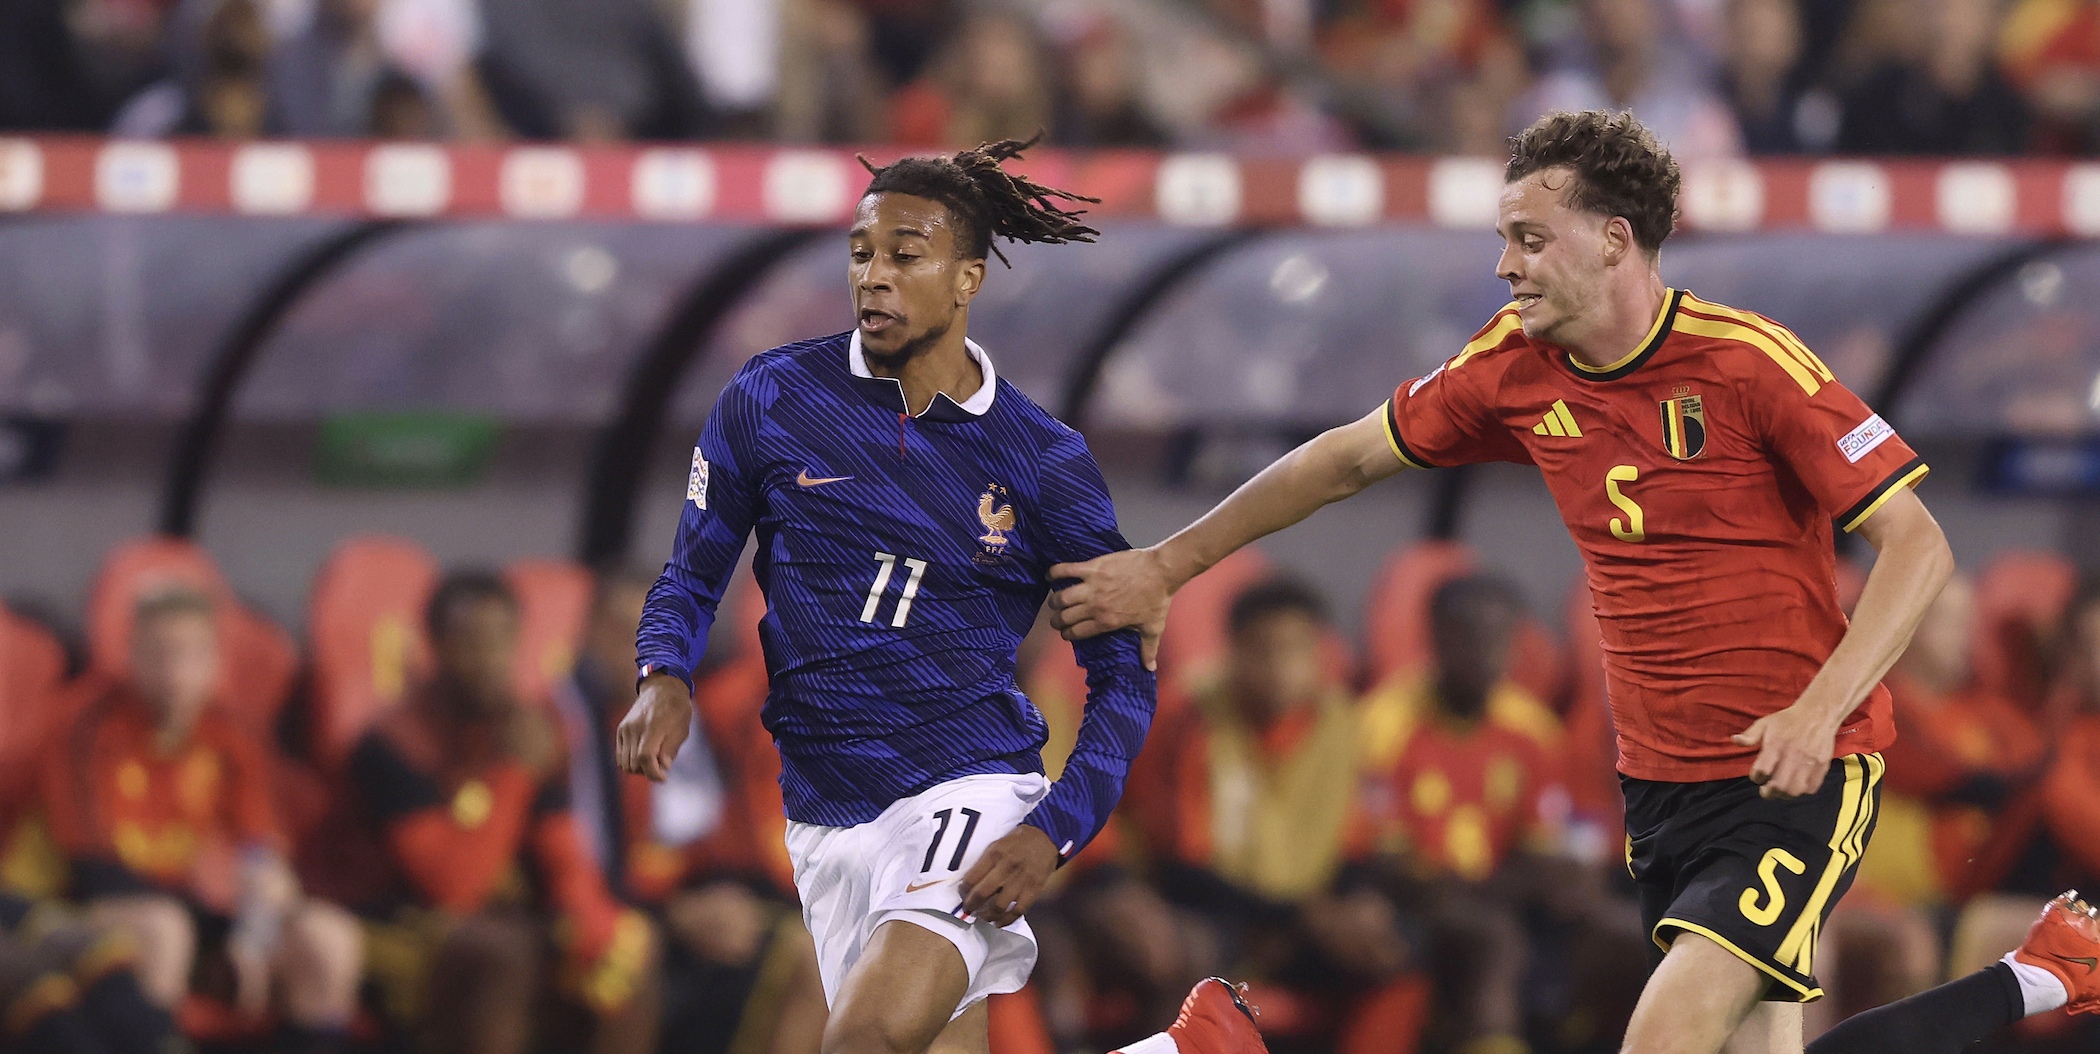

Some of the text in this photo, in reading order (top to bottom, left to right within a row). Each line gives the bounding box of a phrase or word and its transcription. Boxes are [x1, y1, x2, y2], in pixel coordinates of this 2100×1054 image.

[1840, 433, 1856, 447] UEFA
[1605, 465, 1645, 542] 5
[859, 551, 928, 628] 11
[920, 807, 982, 874] 11
[1738, 847, 1806, 927] 5
